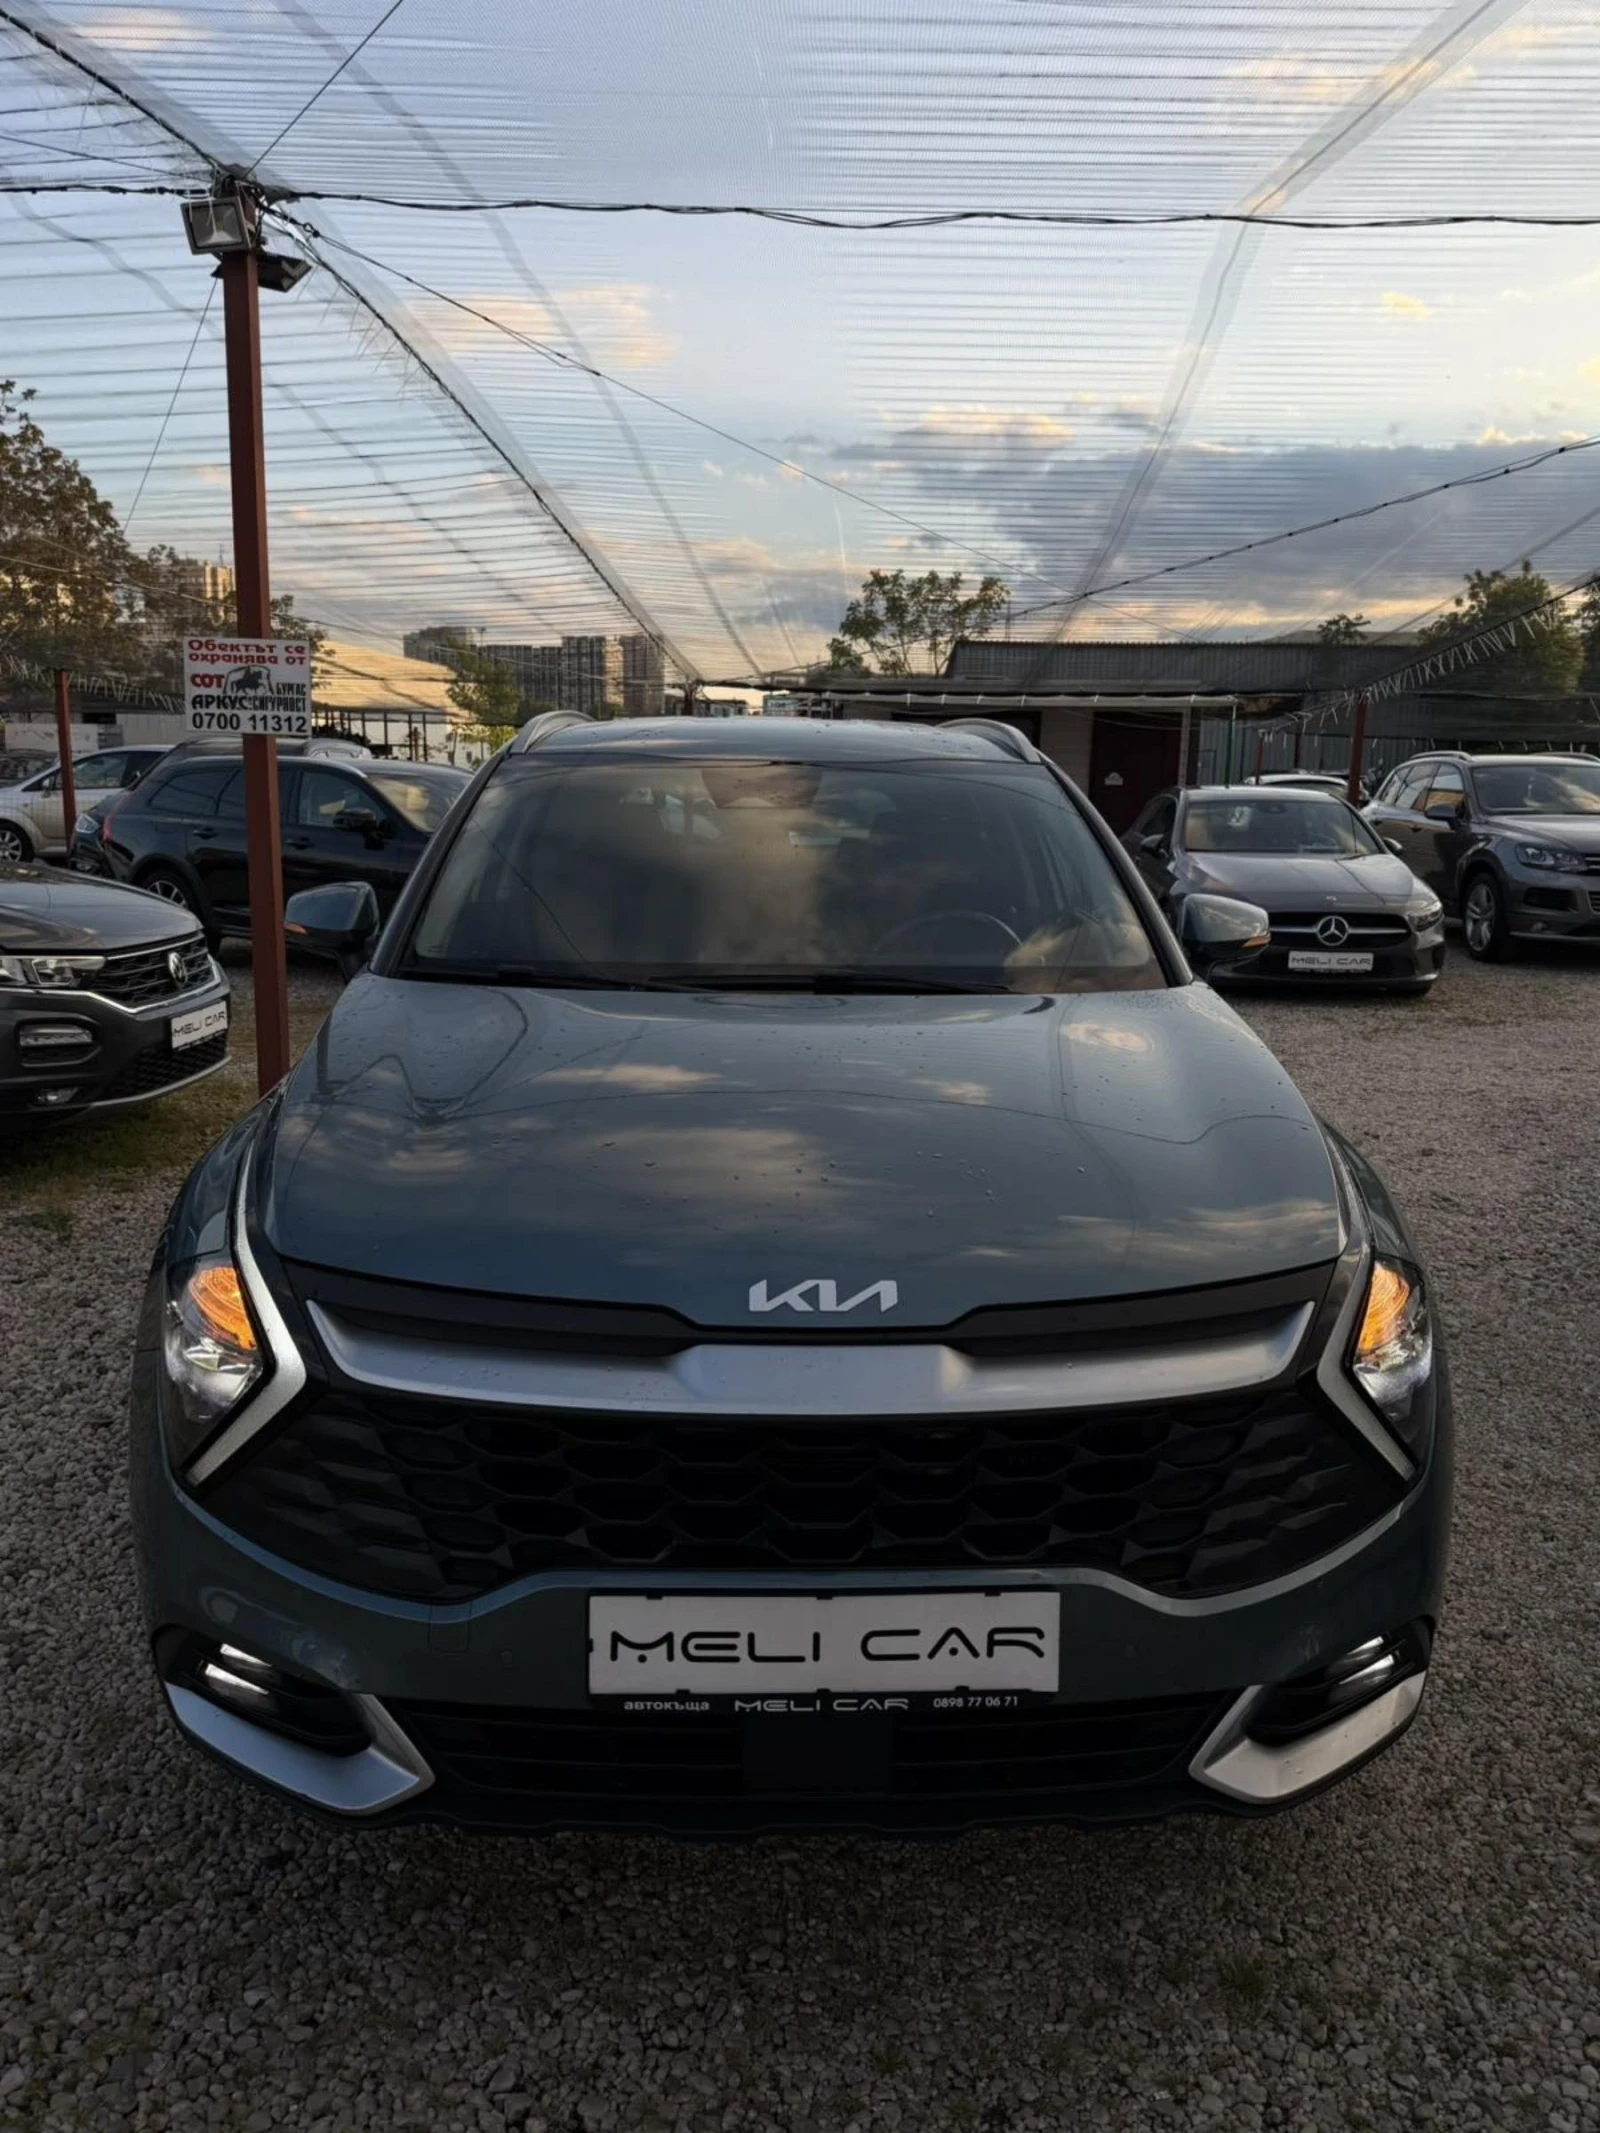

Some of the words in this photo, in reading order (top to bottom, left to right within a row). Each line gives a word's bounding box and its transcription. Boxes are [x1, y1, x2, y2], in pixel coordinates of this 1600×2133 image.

[188, 639, 277, 653] Обектът
[284, 645, 306, 654] се
[188, 653, 279, 665] охранява
[285, 656, 306, 665] от
[190, 673, 225, 688] СОТ
[276, 682, 306, 696] БУРГАС
[192, 712, 241, 730] 0700
[248, 714, 307, 733] 11312
[1336, 957, 1372, 966] CAR
[204, 1011, 225, 1027] CAR
[749, 1279, 898, 1312] KIA
[610, 1631, 821, 1664] MELI
[860, 1626, 1045, 1662] CAR
[623, 1700, 710, 1712] автокъща
[734, 1699, 821, 1712] MELI
[833, 1698, 909, 1711] CAR
[933, 1697, 964, 1708] 0898
[967, 1697, 982, 1708] 77
[985, 1696, 1001, 1707] 06
[1004, 1696, 1018, 1706] 71
